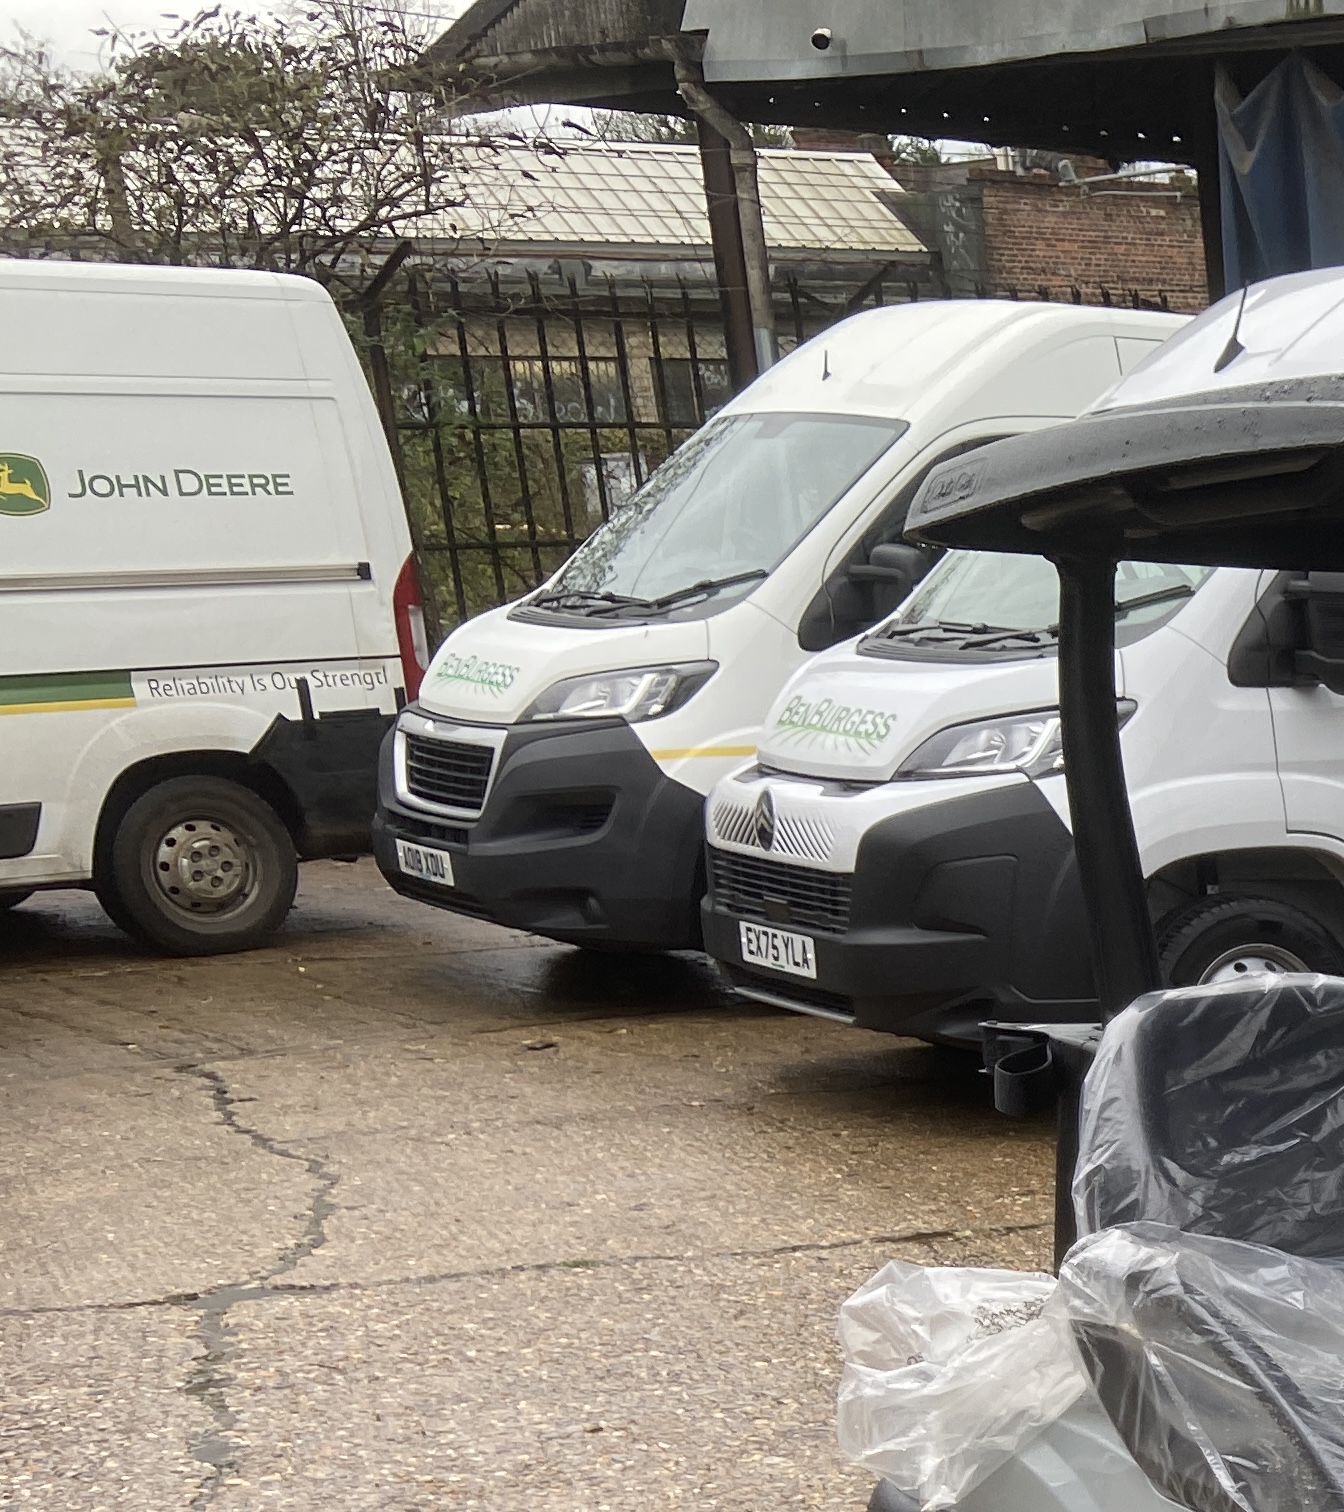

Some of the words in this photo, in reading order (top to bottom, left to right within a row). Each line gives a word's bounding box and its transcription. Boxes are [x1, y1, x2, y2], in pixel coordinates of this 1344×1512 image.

[67, 469, 170, 499] JOHN
[174, 469, 294, 497] DEERE
[147, 675, 246, 698] Reliability
[250, 673, 267, 692] Is
[745, 926, 780, 962] EX75
[780, 934, 811, 970] YLA
